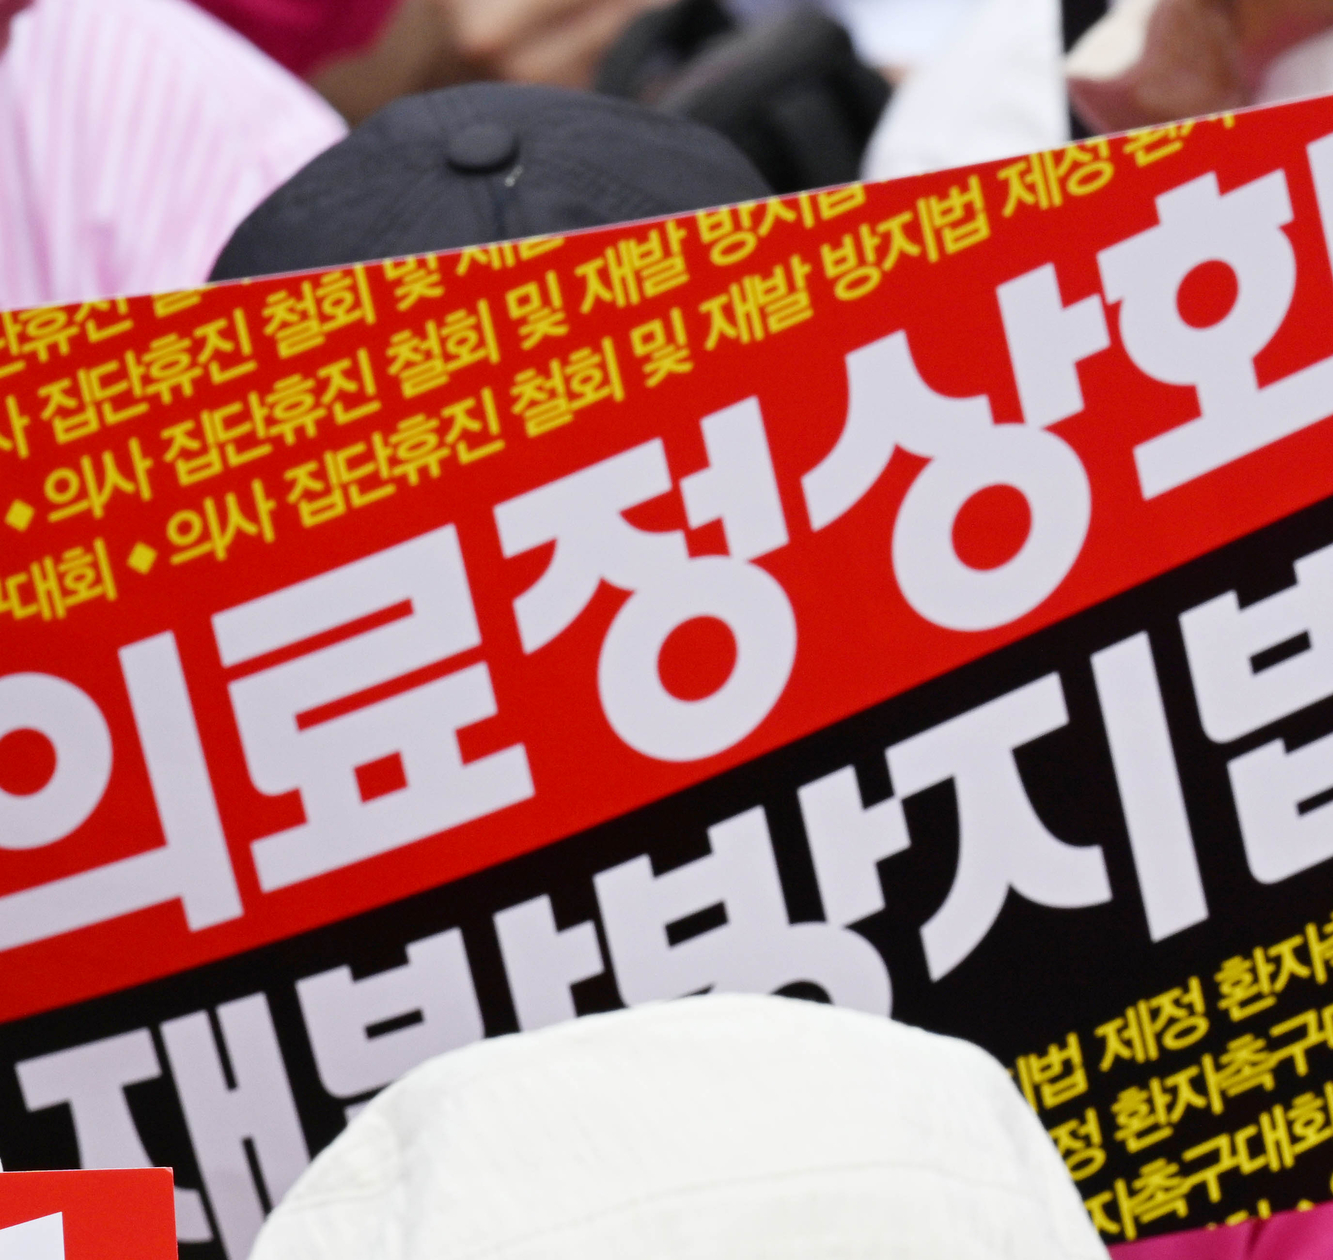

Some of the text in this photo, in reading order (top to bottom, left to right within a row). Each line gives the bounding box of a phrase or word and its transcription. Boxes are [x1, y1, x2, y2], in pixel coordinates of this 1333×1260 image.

[37, 306, 258, 445] 집단휴진
[261, 262, 376, 360] 철회
[44, 437, 154, 523] 의사
[160, 348, 382, 487] 집단휴진
[385, 298, 501, 399] 철회
[504, 269, 570, 351] 및
[573, 217, 690, 315] 재발
[166, 478, 277, 562] 의사
[284, 389, 506, 529] 집단휴진
[509, 336, 625, 438] 철회
[629, 306, 695, 389] 및
[698, 254, 814, 352] 재발
[819, 174, 992, 302] 방지법
[1093, 975, 1210, 1073] 제정
